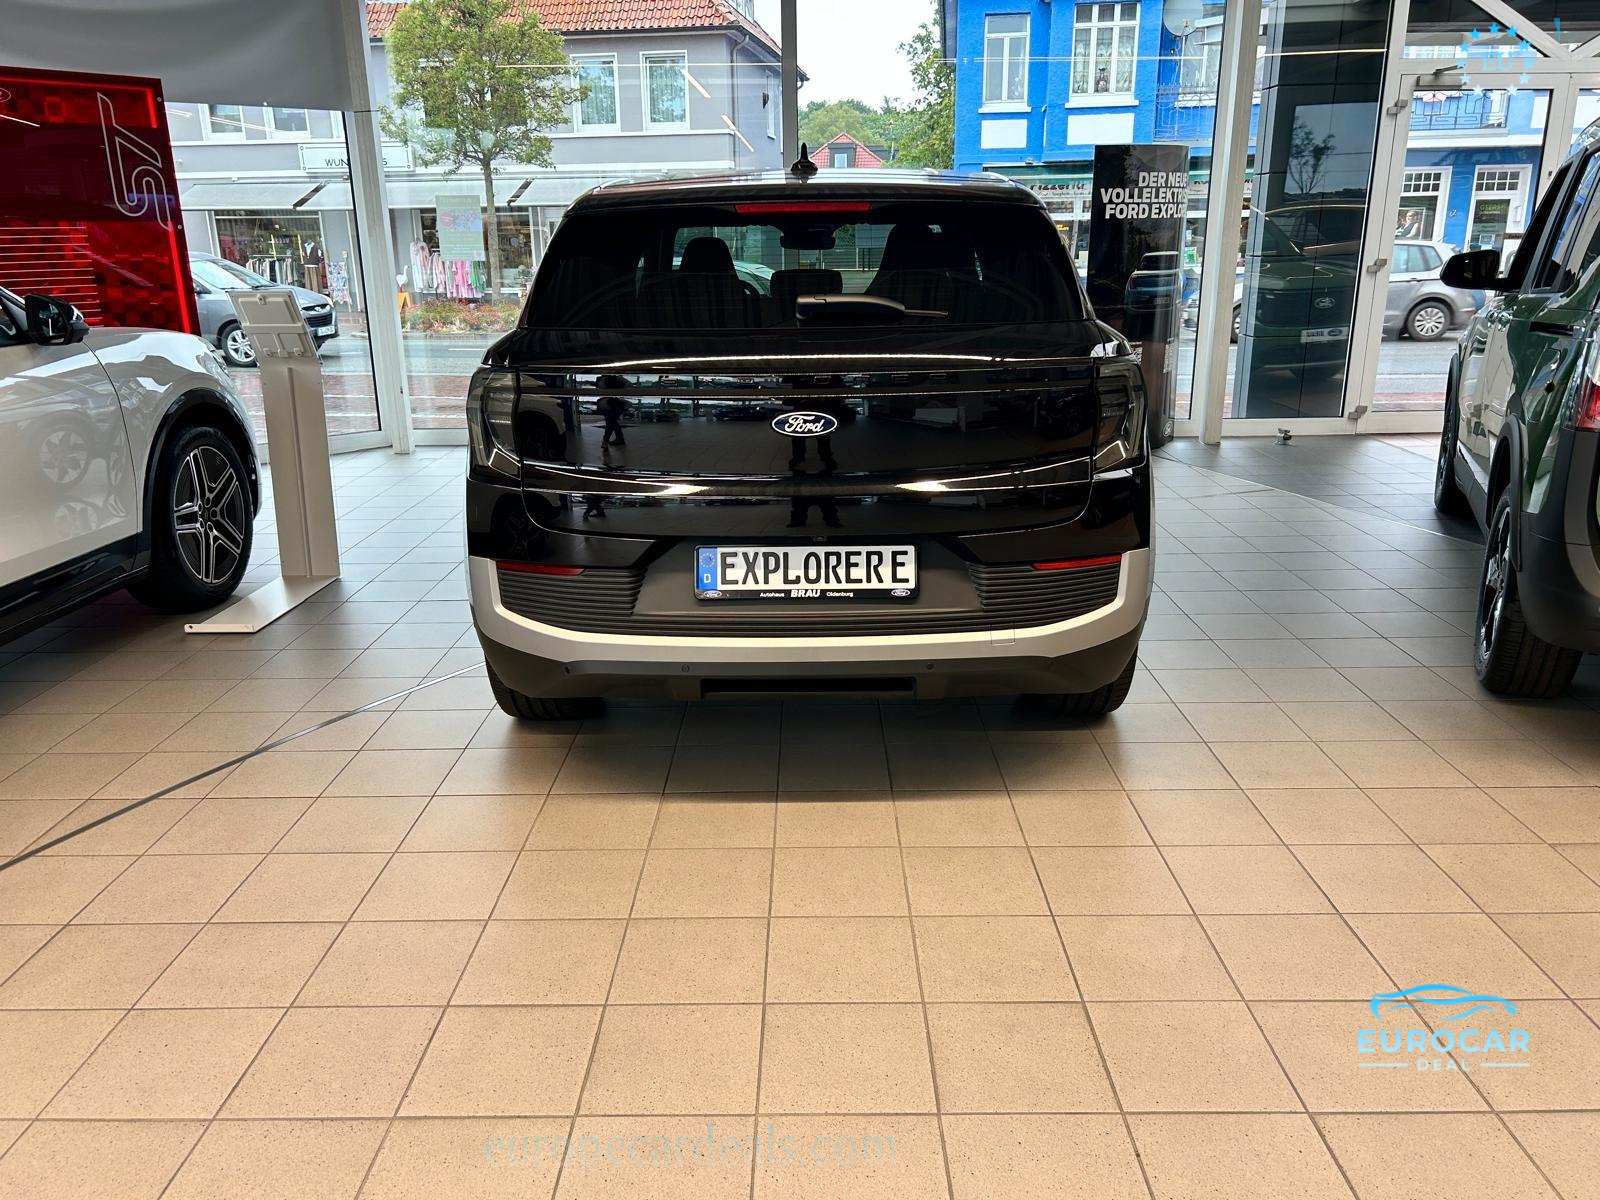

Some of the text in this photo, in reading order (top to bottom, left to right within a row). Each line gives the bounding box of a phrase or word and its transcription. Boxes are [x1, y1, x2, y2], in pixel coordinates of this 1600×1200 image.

[1138, 171, 1167, 187] DER
[1105, 203, 1149, 219] FORD
[782, 414, 827, 433] Ford
[703, 573, 712, 583] D
[790, 588, 821, 598] BRAU
